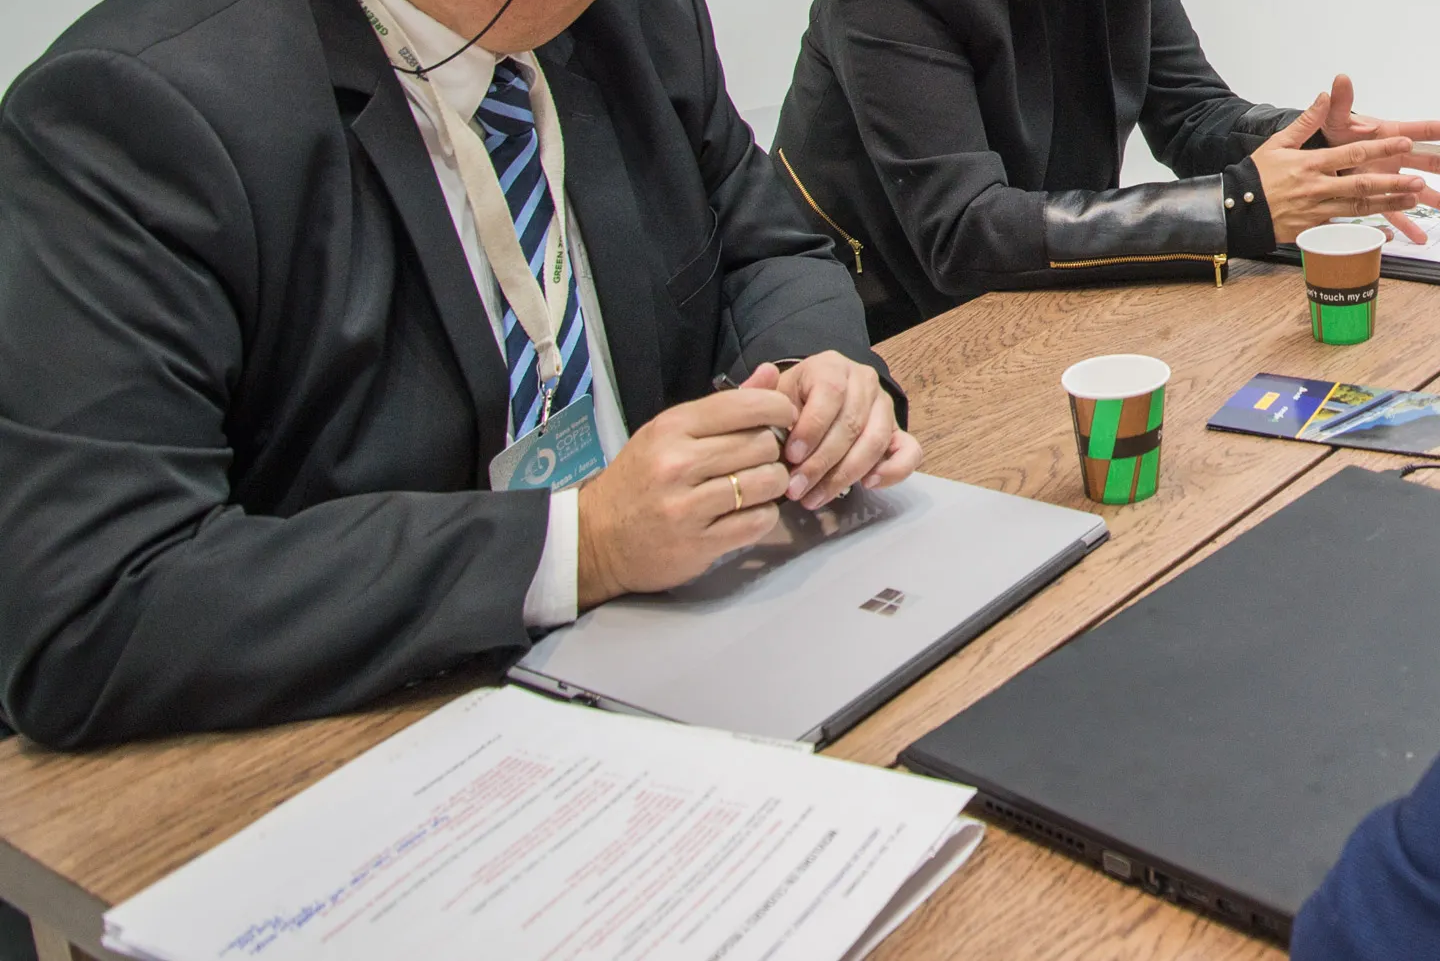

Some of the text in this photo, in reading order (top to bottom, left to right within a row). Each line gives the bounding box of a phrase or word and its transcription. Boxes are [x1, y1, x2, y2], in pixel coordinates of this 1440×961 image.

[553, 251, 564, 284] GREEN
[1319, 292, 1345, 302] touch
[1347, 293, 1361, 303] my
[1362, 288, 1375, 299] cup
